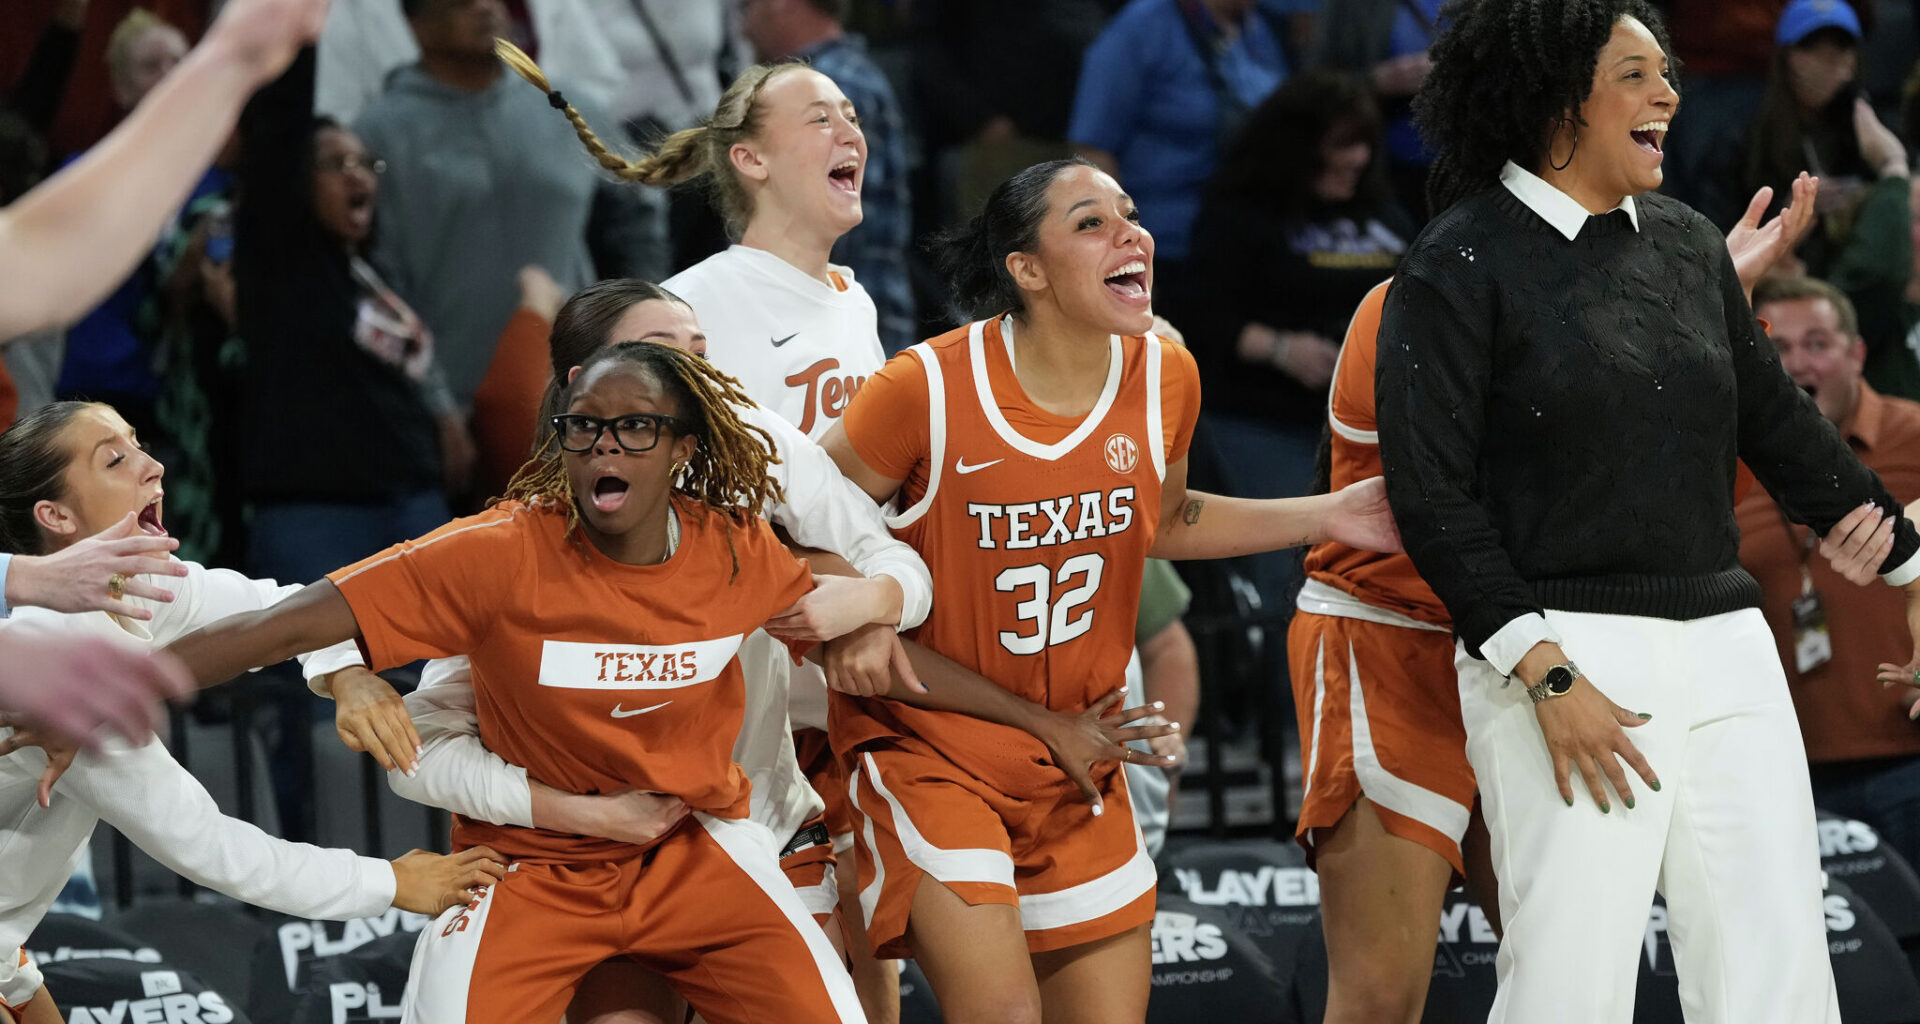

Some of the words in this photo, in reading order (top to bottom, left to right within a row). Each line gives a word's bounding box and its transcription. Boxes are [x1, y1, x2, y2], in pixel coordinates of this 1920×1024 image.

[1107, 436, 1136, 470] SEC
[967, 486, 1135, 550] TEXAS
[994, 552, 1105, 656] 32
[594, 651, 697, 682] TEXAS
